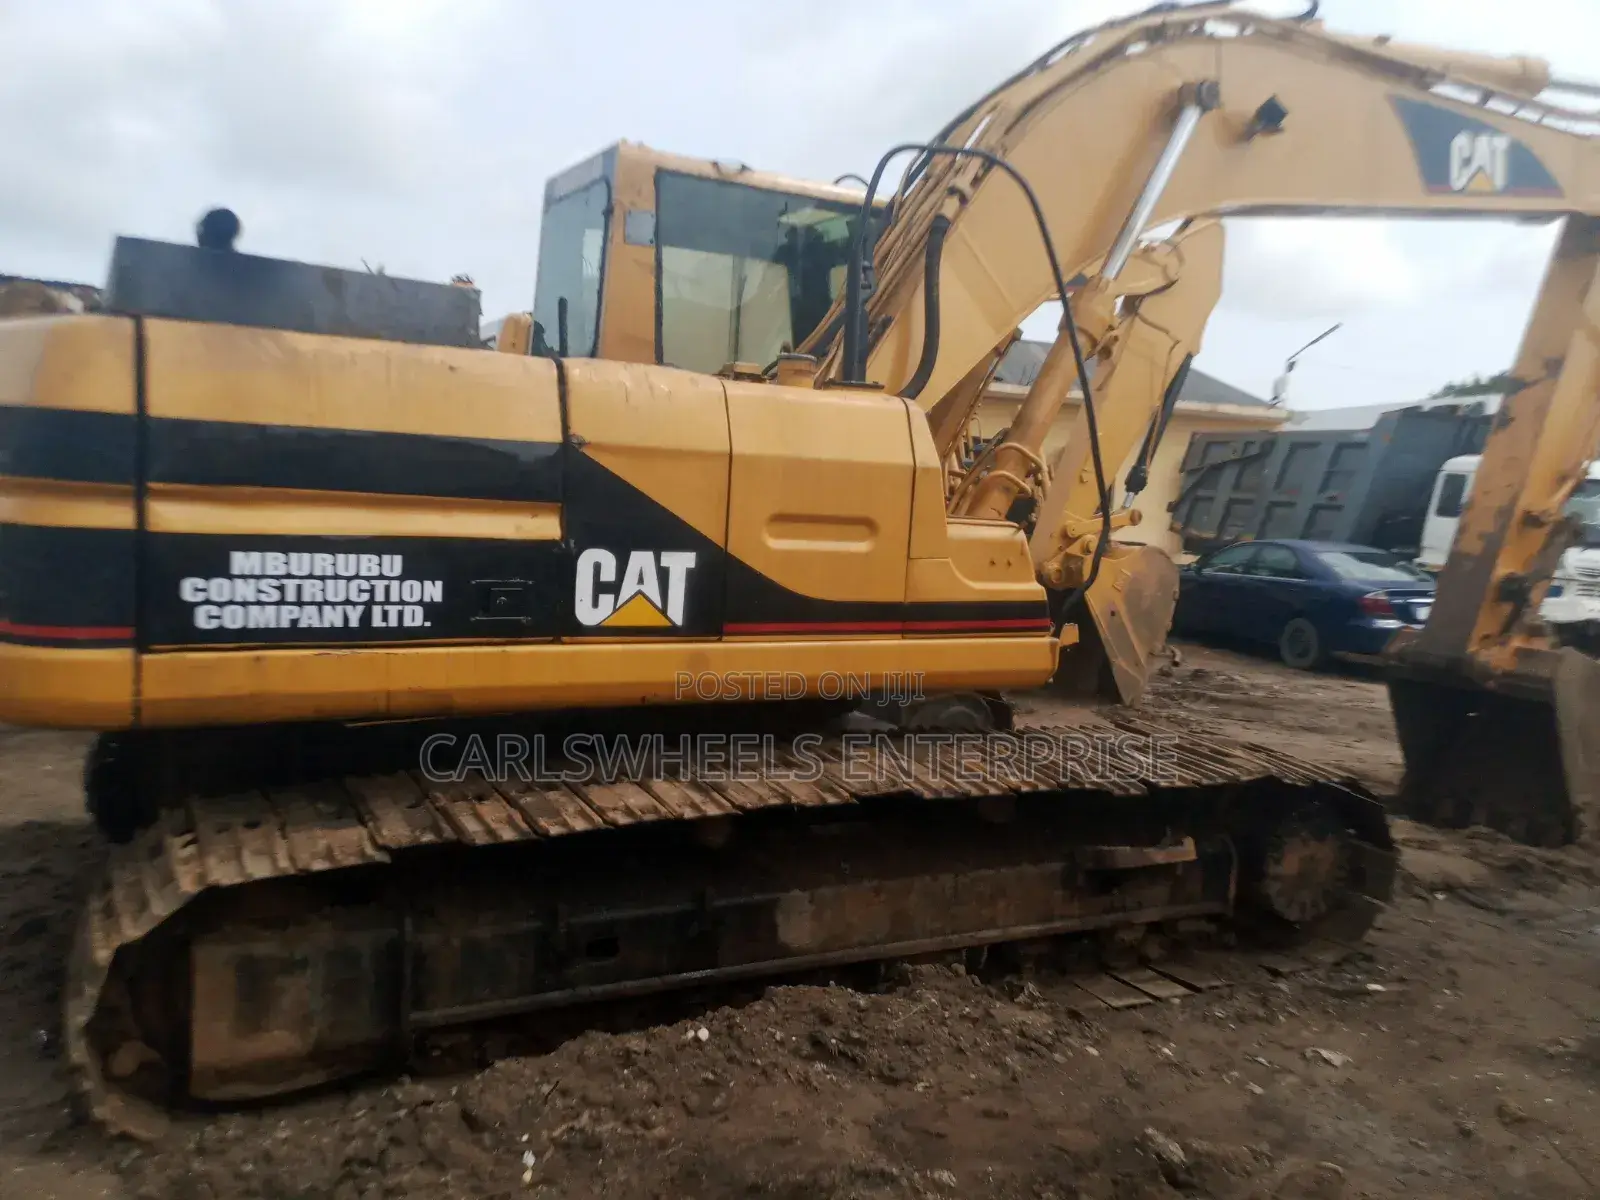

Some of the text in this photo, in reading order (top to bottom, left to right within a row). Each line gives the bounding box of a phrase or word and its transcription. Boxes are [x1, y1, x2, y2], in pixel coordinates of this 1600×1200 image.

[1450, 130, 1510, 191] CAT
[230, 551, 403, 577] MBURUBU
[180, 577, 443, 602] CONSTRUCTION
[575, 548, 697, 626] CAT
[194, 604, 432, 629] COMPANY LTD.
